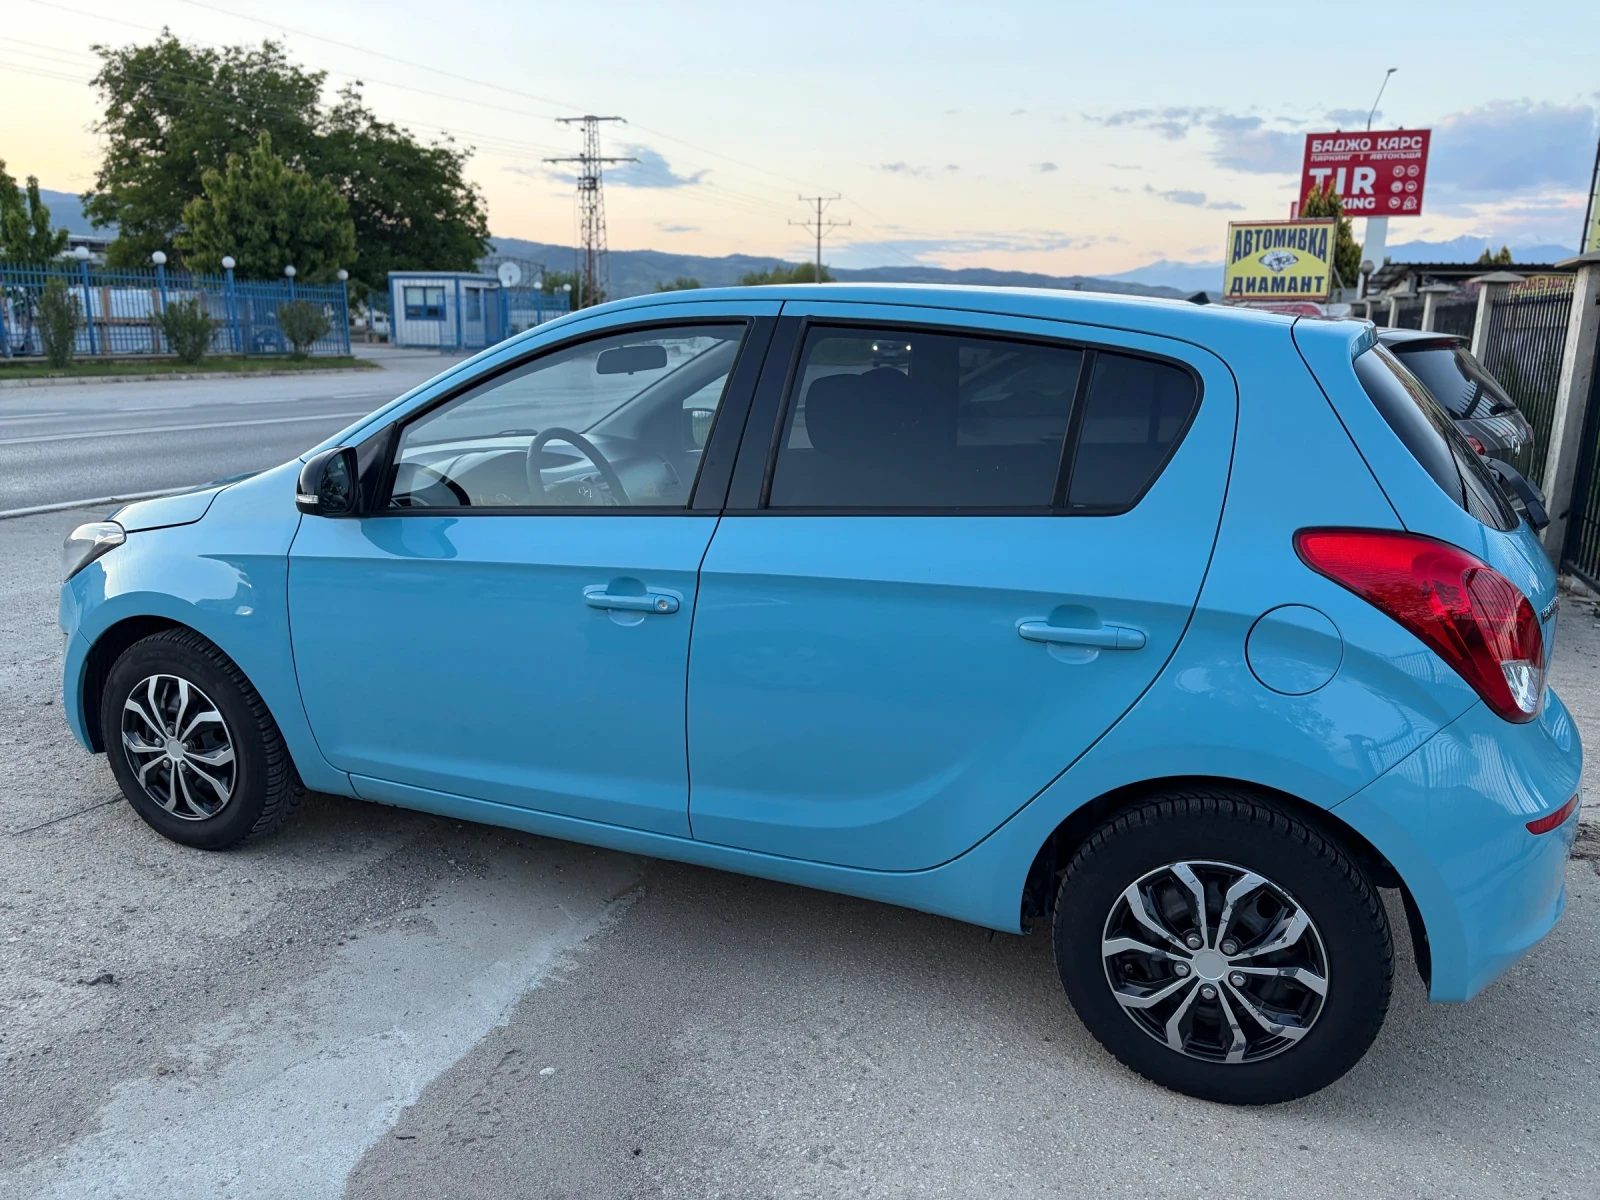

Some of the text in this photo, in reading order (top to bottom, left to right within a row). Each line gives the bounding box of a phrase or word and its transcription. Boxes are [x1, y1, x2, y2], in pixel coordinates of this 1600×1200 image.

[1311, 136, 1423, 153] БАДЖО КАРС
[1310, 154, 1352, 163] ПАРКИНГ
[1308, 166, 1377, 195] TIR
[1340, 197, 1376, 210] KING
[1231, 227, 1328, 265] АВТОМИВКА
[1229, 275, 1325, 296] ДИАМАНТ
